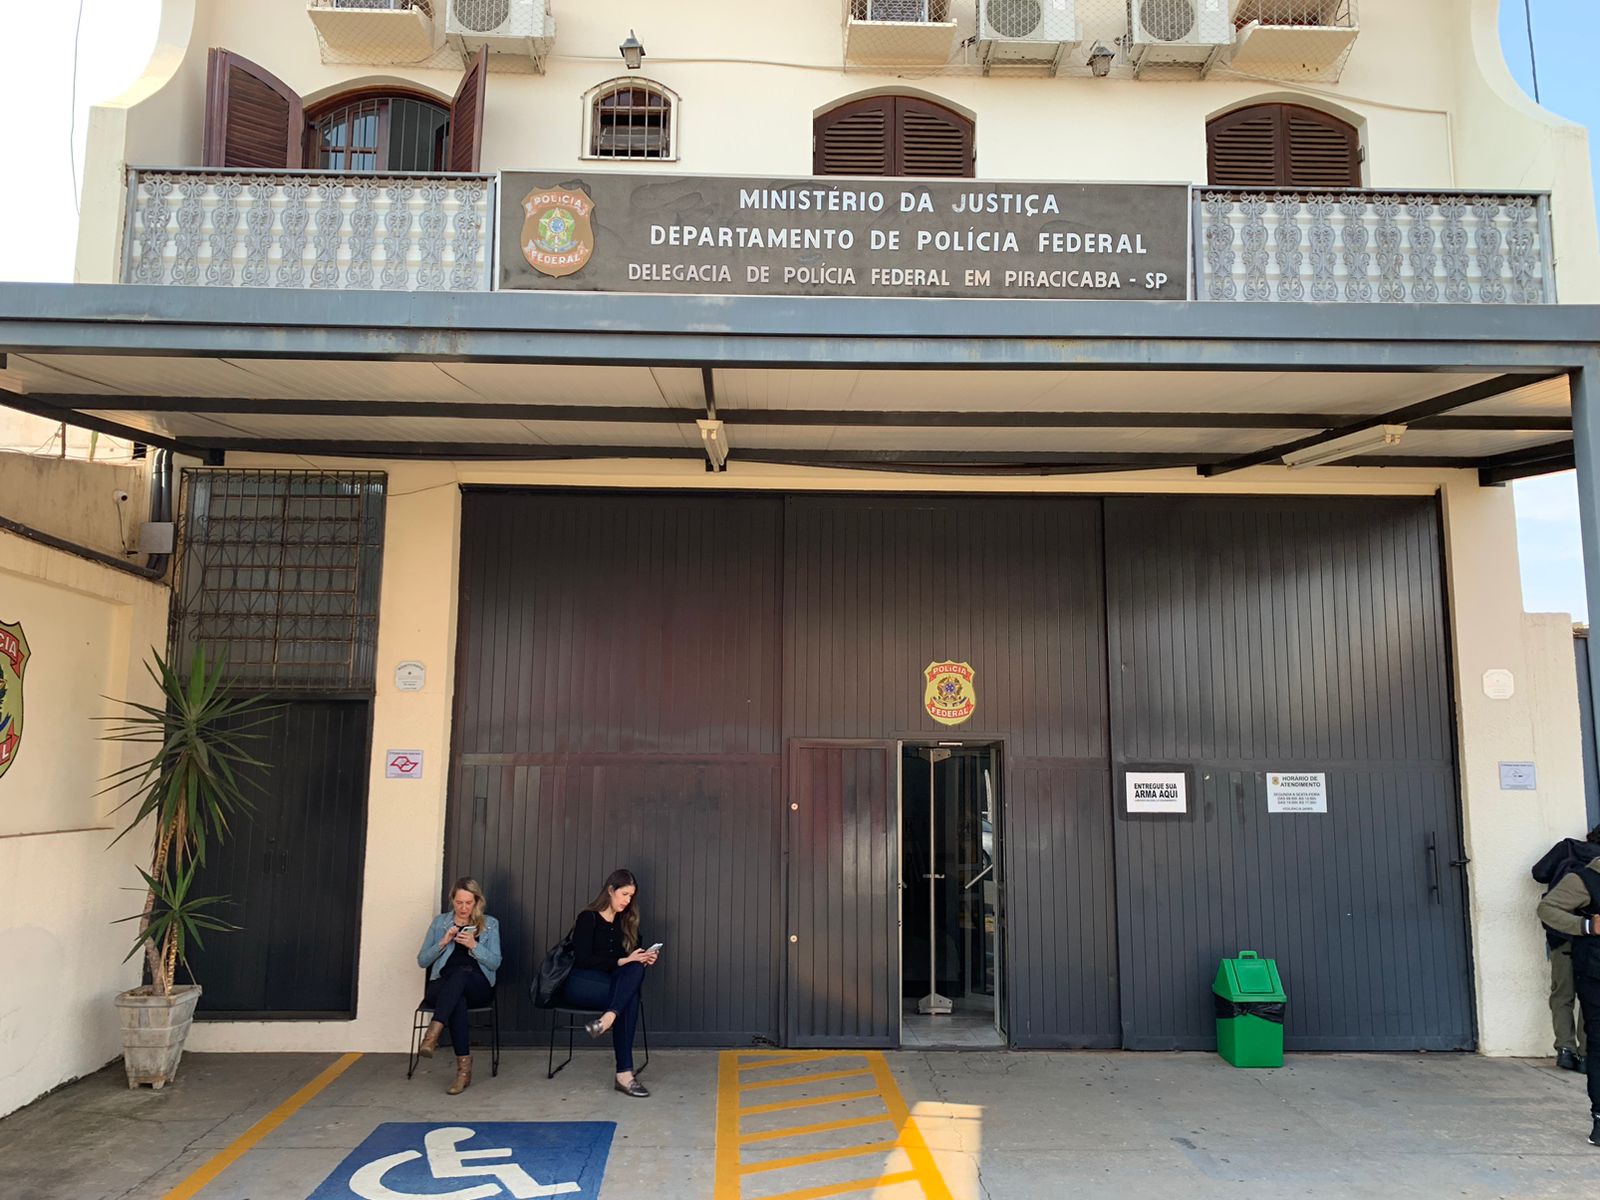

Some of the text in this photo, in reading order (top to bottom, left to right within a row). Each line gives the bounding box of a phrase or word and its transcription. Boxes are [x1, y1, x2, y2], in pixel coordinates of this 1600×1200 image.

[740, 186, 1060, 217] MINISTÉRIO DA JUSTIÇA
[651, 225, 1147, 254] DEPARTAMENTO DE POLÍCIA FEDERAL
[531, 250, 581, 265] FEDERAL
[628, 264, 732, 282] DELEGACIA
[747, 266, 770, 283] DE
[784, 262, 856, 285] POLÍCIA
[872, 268, 950, 286] FEDERAL
[965, 269, 991, 286] EM
[1005, 270, 1121, 288] PIRACICABA
[1145, 272, 1168, 289] SP
[931, 707, 968, 718] FEDERAL
[1134, 782, 1164, 790] ENTREGUE
[1135, 790, 1178, 799] ARMA AQUI
